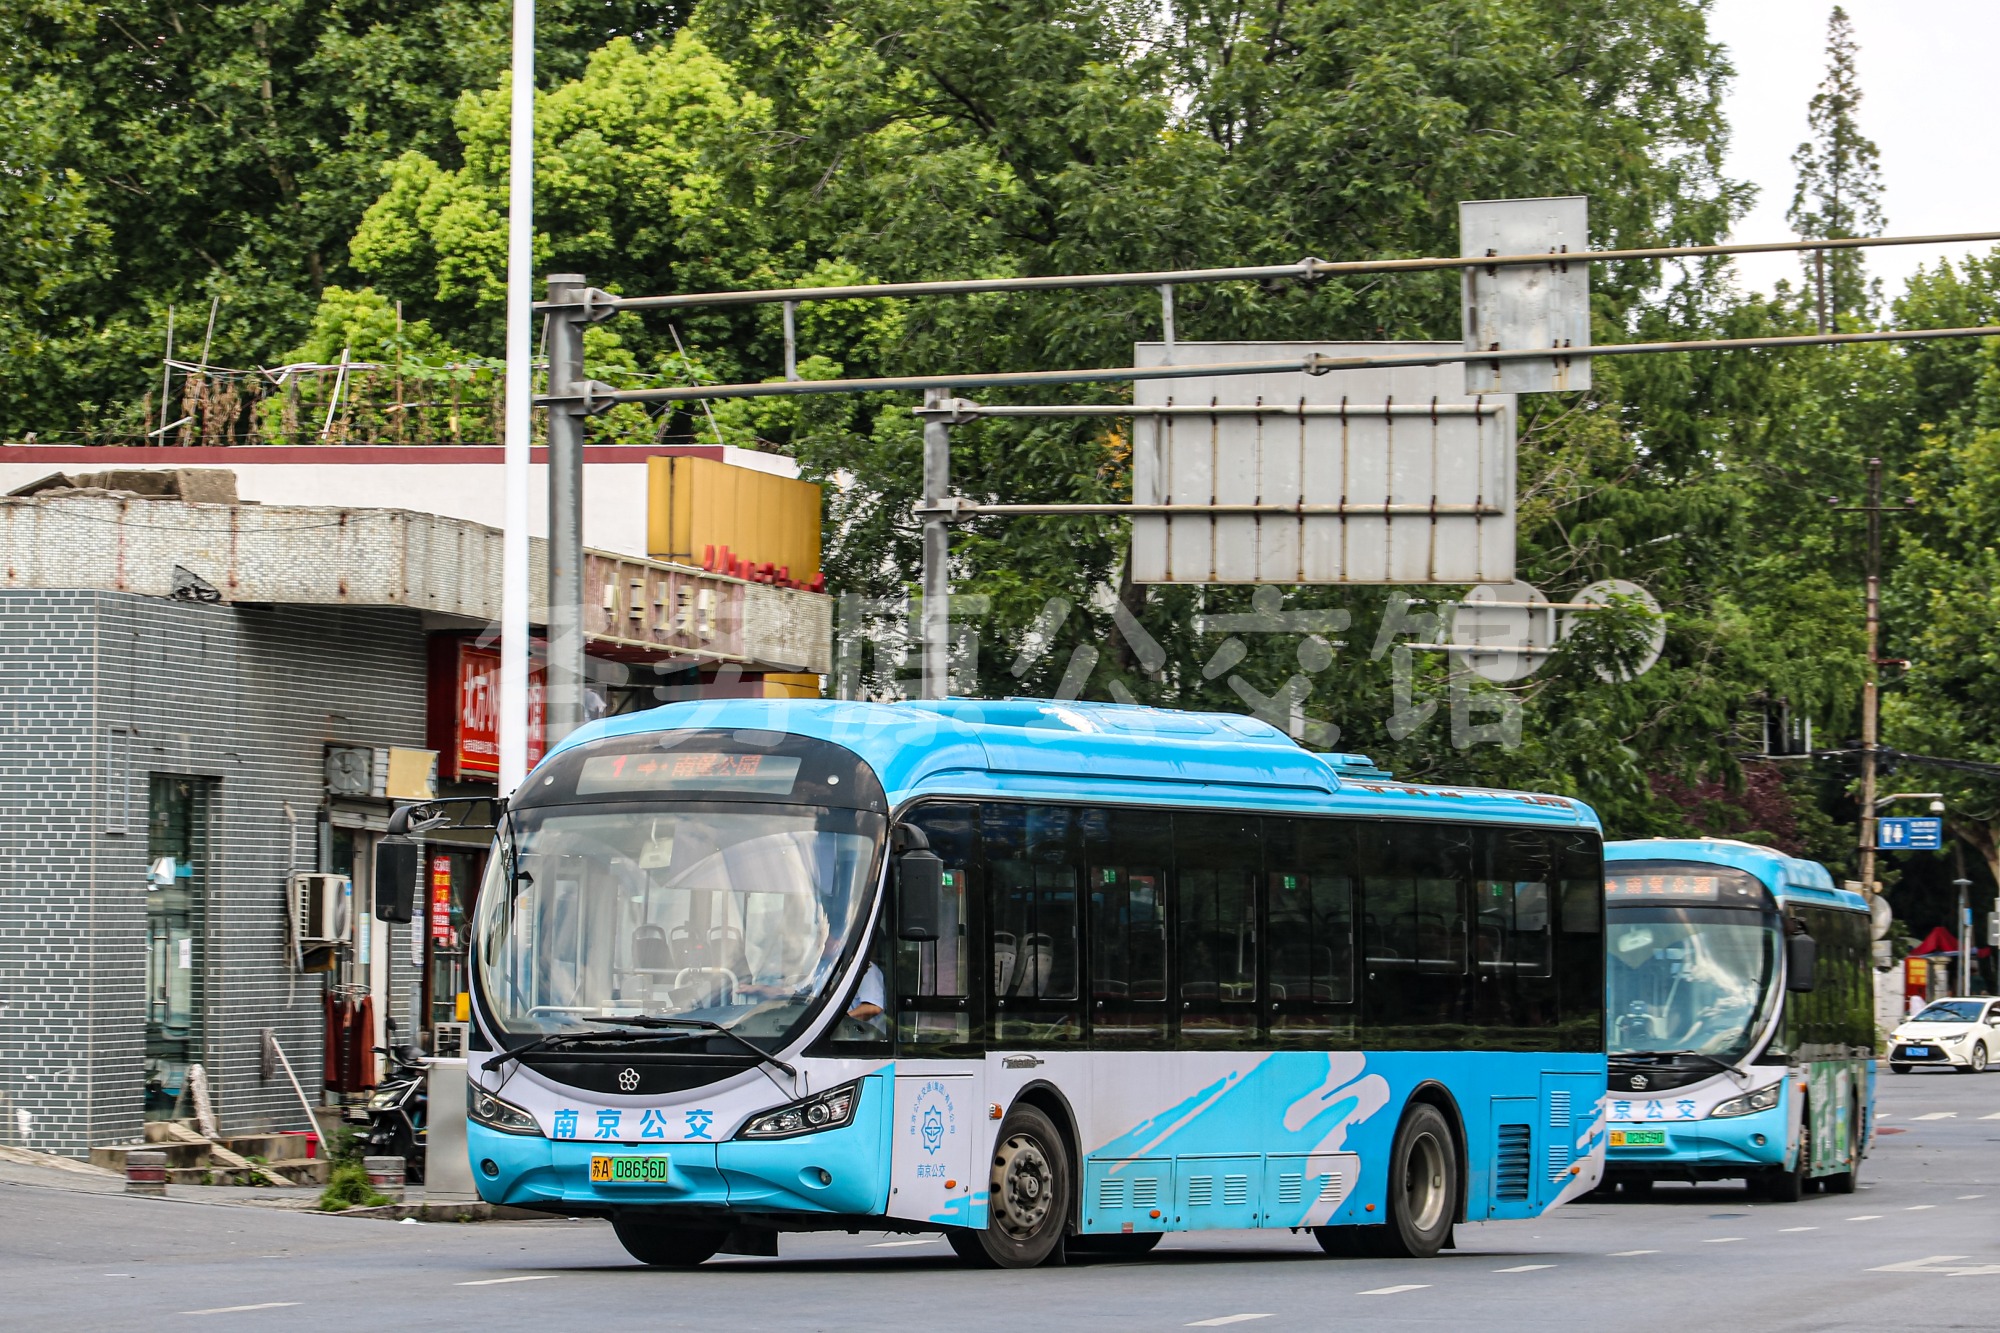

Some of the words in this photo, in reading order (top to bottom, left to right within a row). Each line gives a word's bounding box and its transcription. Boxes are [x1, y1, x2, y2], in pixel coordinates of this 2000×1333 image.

[611, 755, 627, 778] 1
[1613, 1100, 1695, 1119] 京公交
[553, 1108, 714, 1140] 南京公交
[917, 1164, 946, 1178] 南京公交
